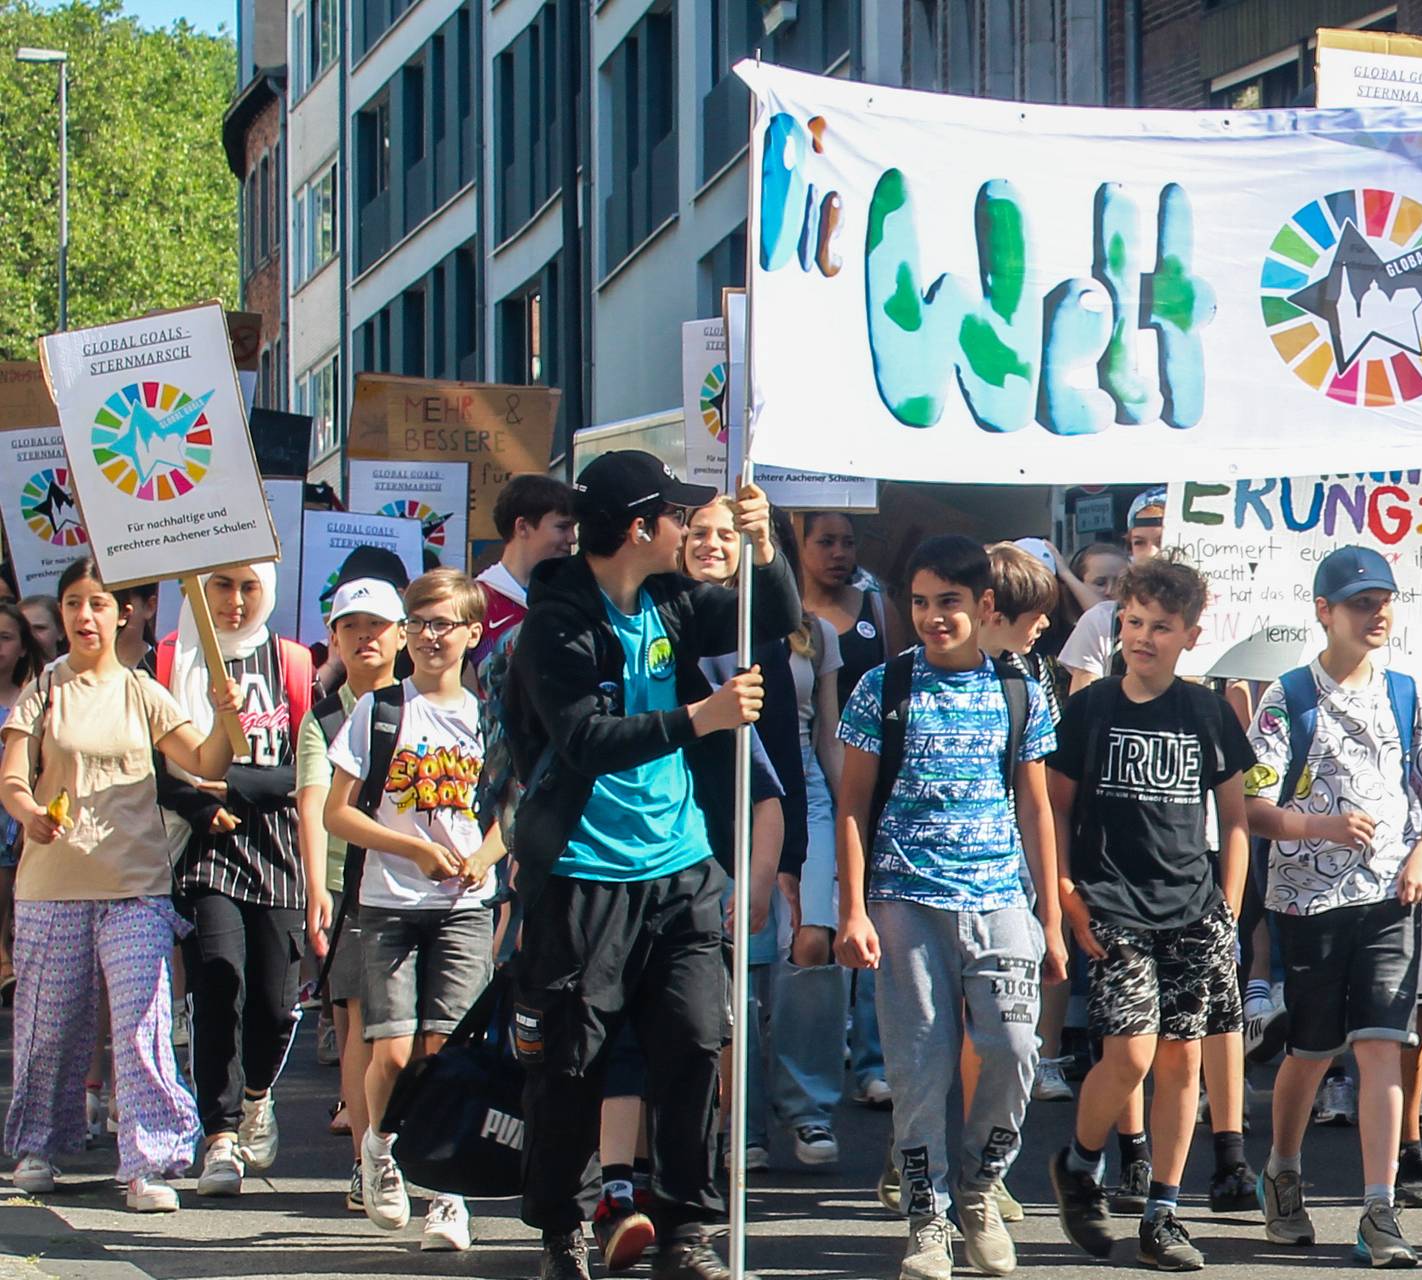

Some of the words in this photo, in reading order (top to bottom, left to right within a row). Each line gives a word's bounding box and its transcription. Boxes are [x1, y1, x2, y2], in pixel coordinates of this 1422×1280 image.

[1354, 65, 1404, 82] GLOBAL
[759, 111, 845, 278] Die
[866, 167, 1217, 436] Welt
[83, 335, 136, 356] GLOBAL
[140, 327, 182, 347] GOALS
[90, 346, 191, 375] STERNMARSCH
[404, 396, 474, 423] MEHR
[506, 393, 523, 424] &
[11, 437, 48, 449] GLOBAL
[404, 428, 505, 453] BESSERE
[372, 469, 408, 480] GLOBAL
[410, 470, 439, 480] GOALS
[374, 481, 442, 493] STERNMARSCH
[785, 473, 826, 482] Aachener
[127, 522, 144, 533] Für
[147, 511, 205, 530] nachhaltige
[208, 508, 228, 520] und
[327, 522, 364, 535] GLOBAL
[365, 524, 394, 537] GOALS
[107, 534, 161, 556] gerechtere
[163, 528, 210, 545] Aachener
[212, 519, 257, 536] Schulen!
[1230, 585, 1252, 604] hat
[1260, 586, 1285, 601] das
[1249, 614, 1311, 643] Mensch
[1101, 734, 1201, 789] TRUE
